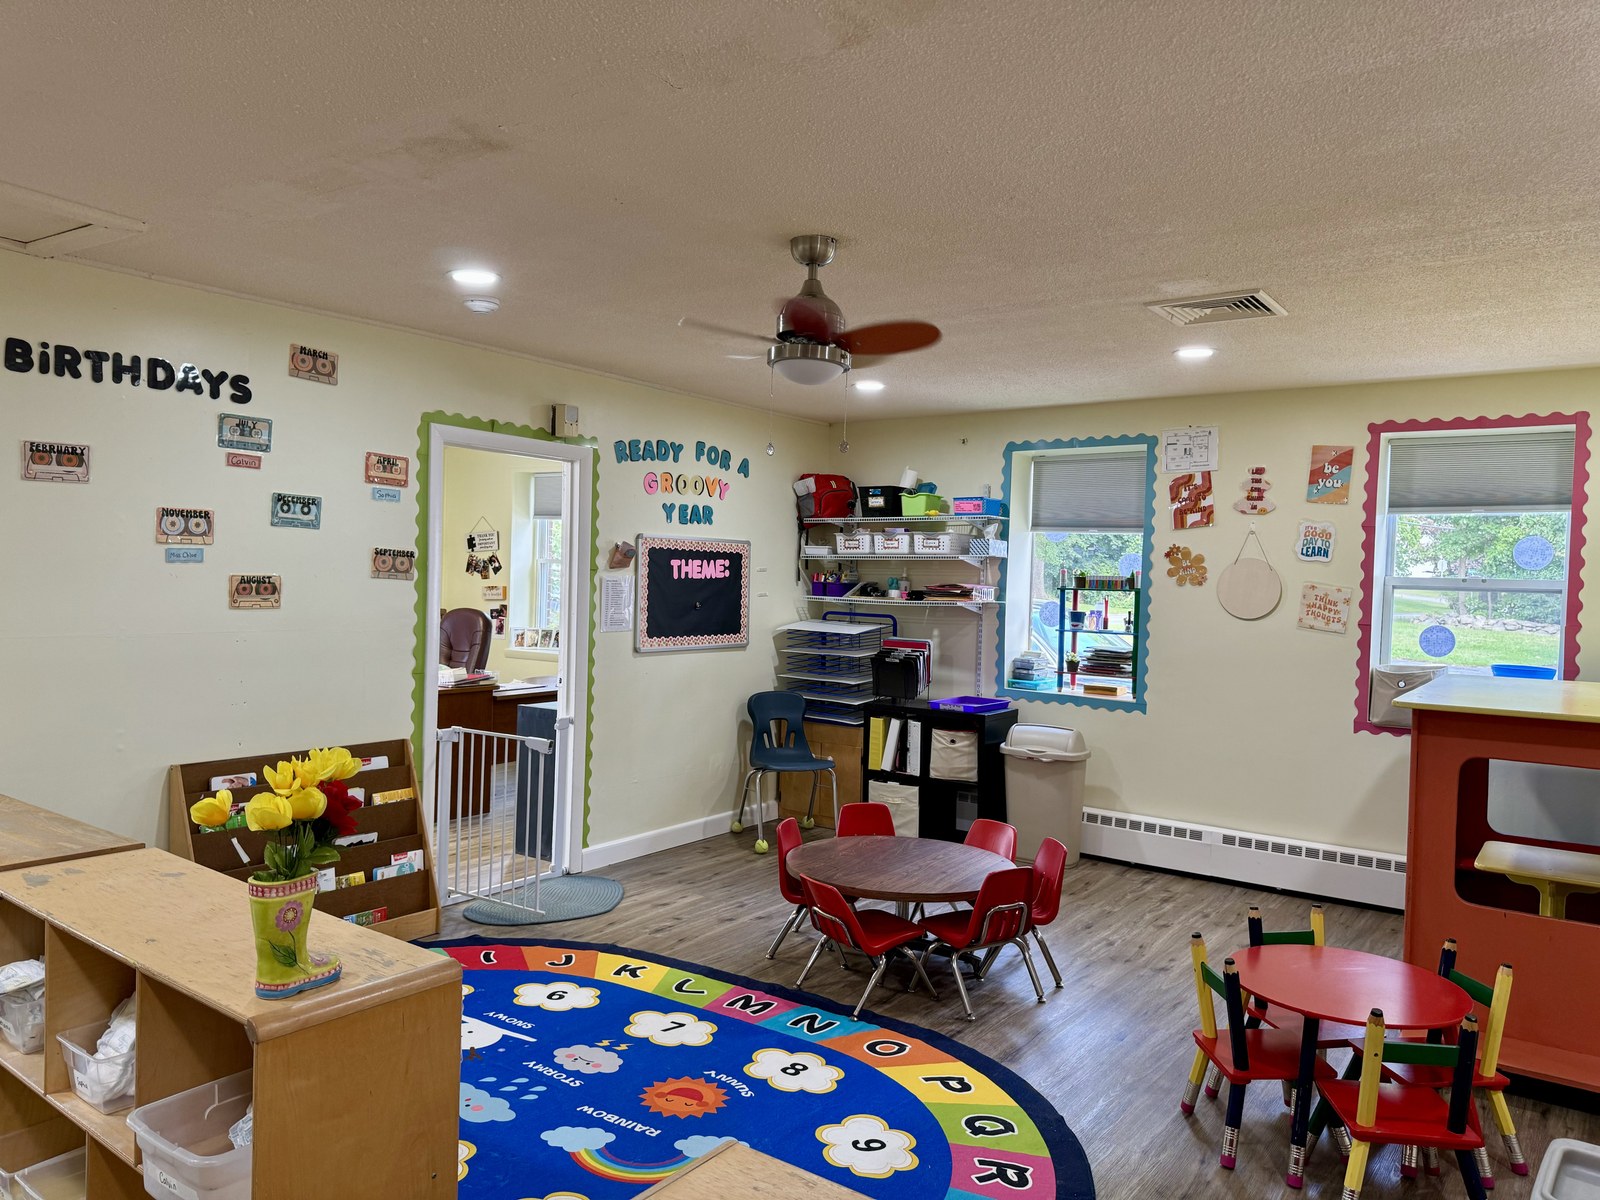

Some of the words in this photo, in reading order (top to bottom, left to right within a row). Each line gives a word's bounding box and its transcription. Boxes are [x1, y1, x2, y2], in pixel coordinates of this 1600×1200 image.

[299, 346, 328, 360] MARCH
[236, 419, 257, 429] JULY
[29, 442, 86, 456] FEBRUARY
[230, 456, 257, 466] Calvin
[376, 456, 399, 466] APRIL
[614, 439, 684, 464] READY
[695, 441, 731, 471] FOR
[737, 458, 750, 478] A
[1323, 462, 1340, 474] be
[643, 472, 730, 500] GROOVY
[1318, 478, 1342, 490] you
[277, 494, 318, 506] DECEMBER
[161, 507, 211, 519] NOVEMBER
[662, 503, 714, 525] YEAR
[1303, 530, 1332, 540] GOOD
[1302, 537, 1319, 548] DAY
[1320, 539, 1331, 549] TO
[374, 547, 415, 559] SEPTEMBER
[1301, 546, 1329, 558] LEARN
[671, 559, 730, 580] THEME:
[239, 575, 273, 585] AUGUST
[1314, 594, 1339, 607] THINK
[1311, 602, 1339, 615] HAPPY
[545, 954, 575, 967] J
[612, 964, 648, 979] K
[673, 978, 707, 995] L
[546, 990, 568, 1001] 6
[723, 994, 777, 1016] M
[483, 1011, 536, 1029] SNOWY
[660, 1021, 687, 1032] 7
[787, 1013, 840, 1035] N
[864, 1039, 912, 1058] O
[522, 1060, 584, 1087] STORMY
[780, 1062, 809, 1077] 8
[704, 1070, 755, 1098] SUNNY
[919, 1075, 976, 1094] P
[576, 1105, 662, 1137] RAINBOW
[961, 1114, 1018, 1138] Q
[851, 1138, 887, 1152] 9
[971, 1158, 1034, 1190] R
